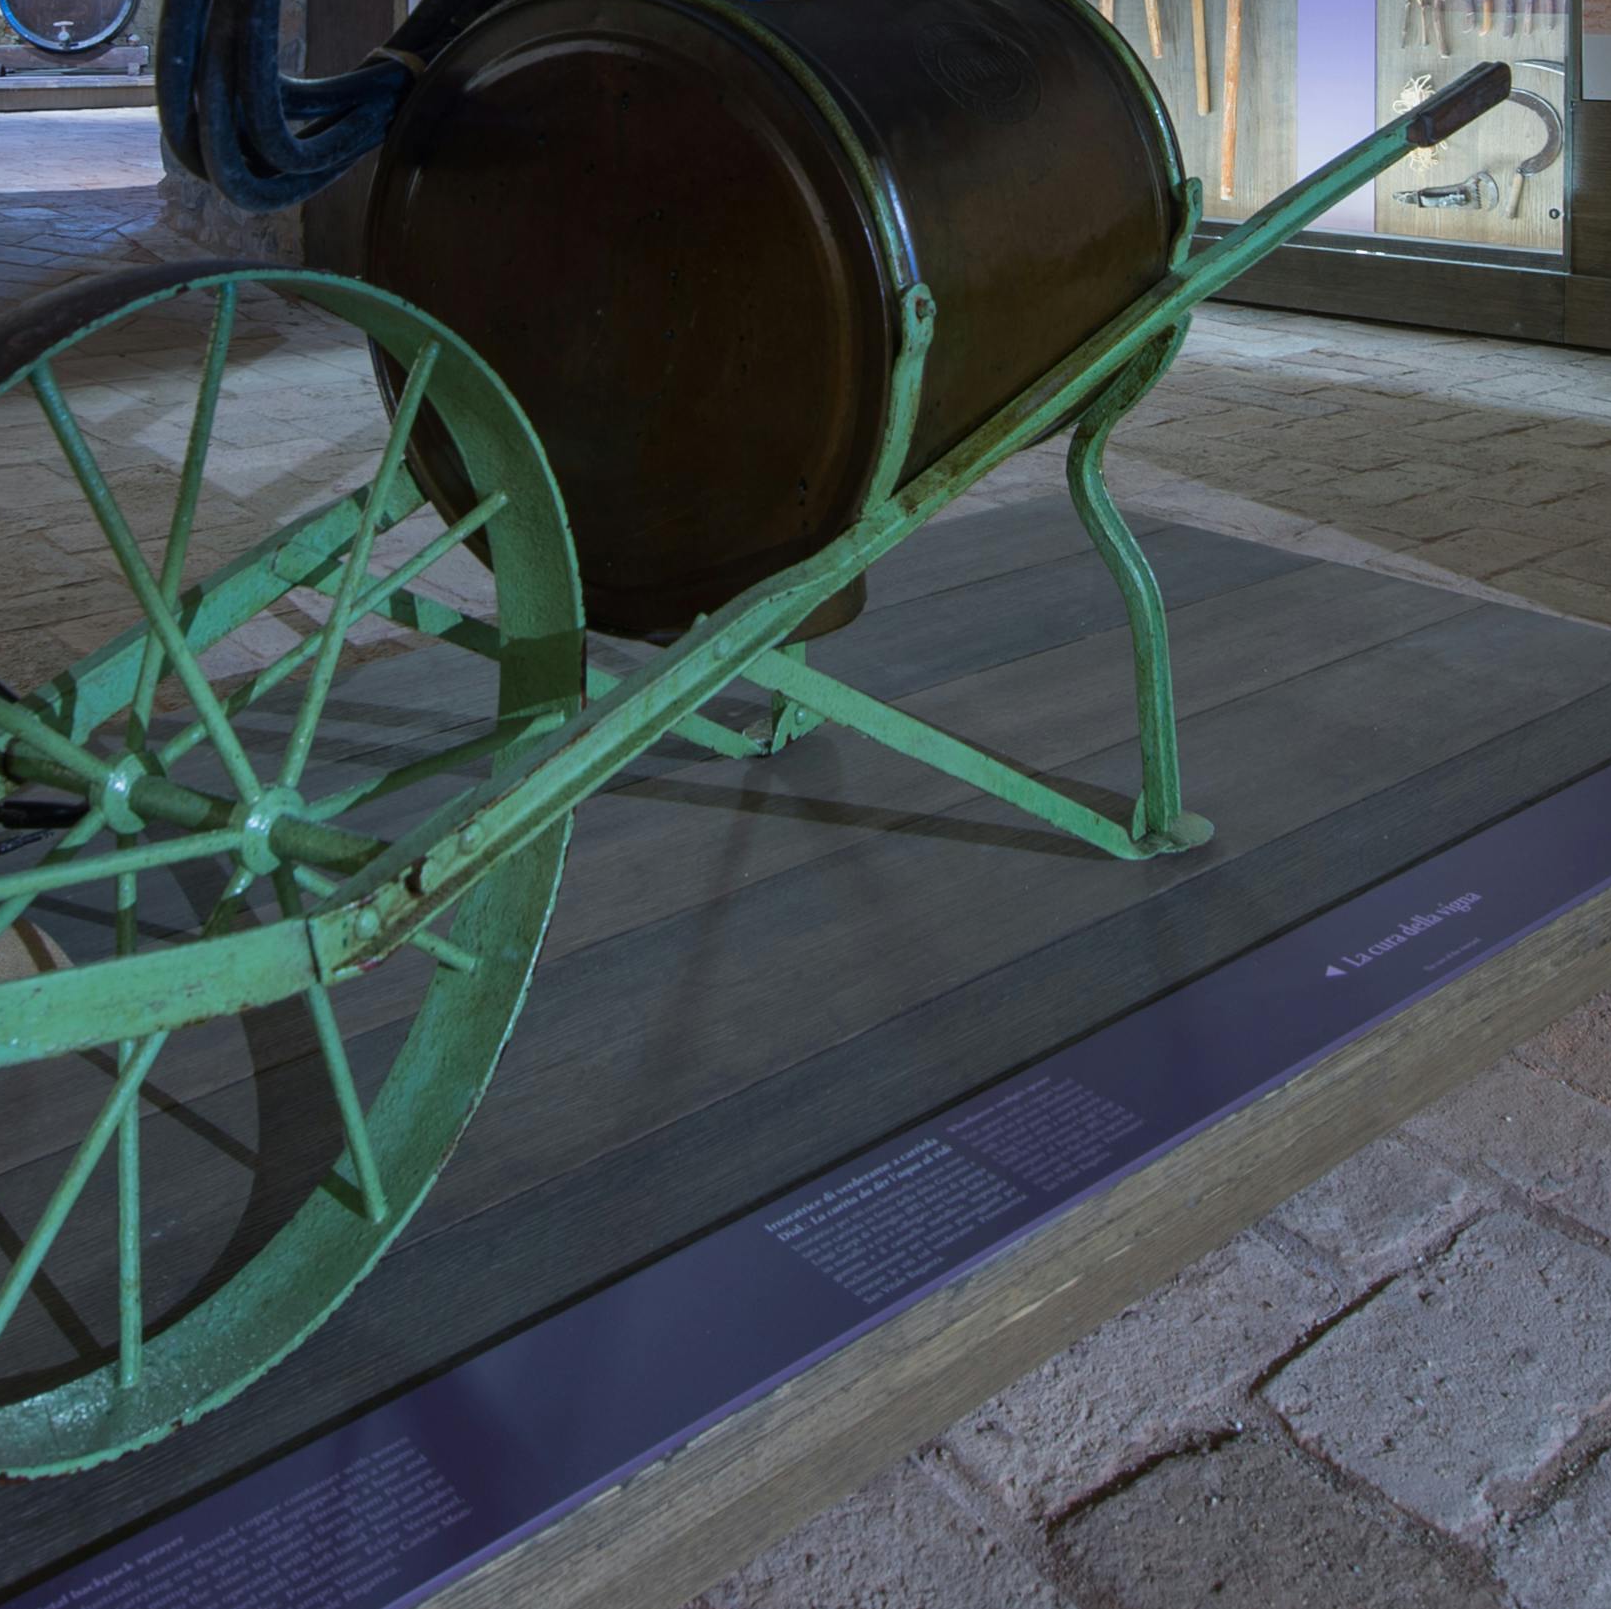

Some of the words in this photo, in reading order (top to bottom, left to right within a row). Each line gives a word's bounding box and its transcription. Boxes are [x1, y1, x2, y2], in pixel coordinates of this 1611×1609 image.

[1341, 952, 1373, 967] La
[1368, 933, 1408, 955] cura
[1397, 914, 1443, 936] della
[1436, 892, 1483, 916] vigna
